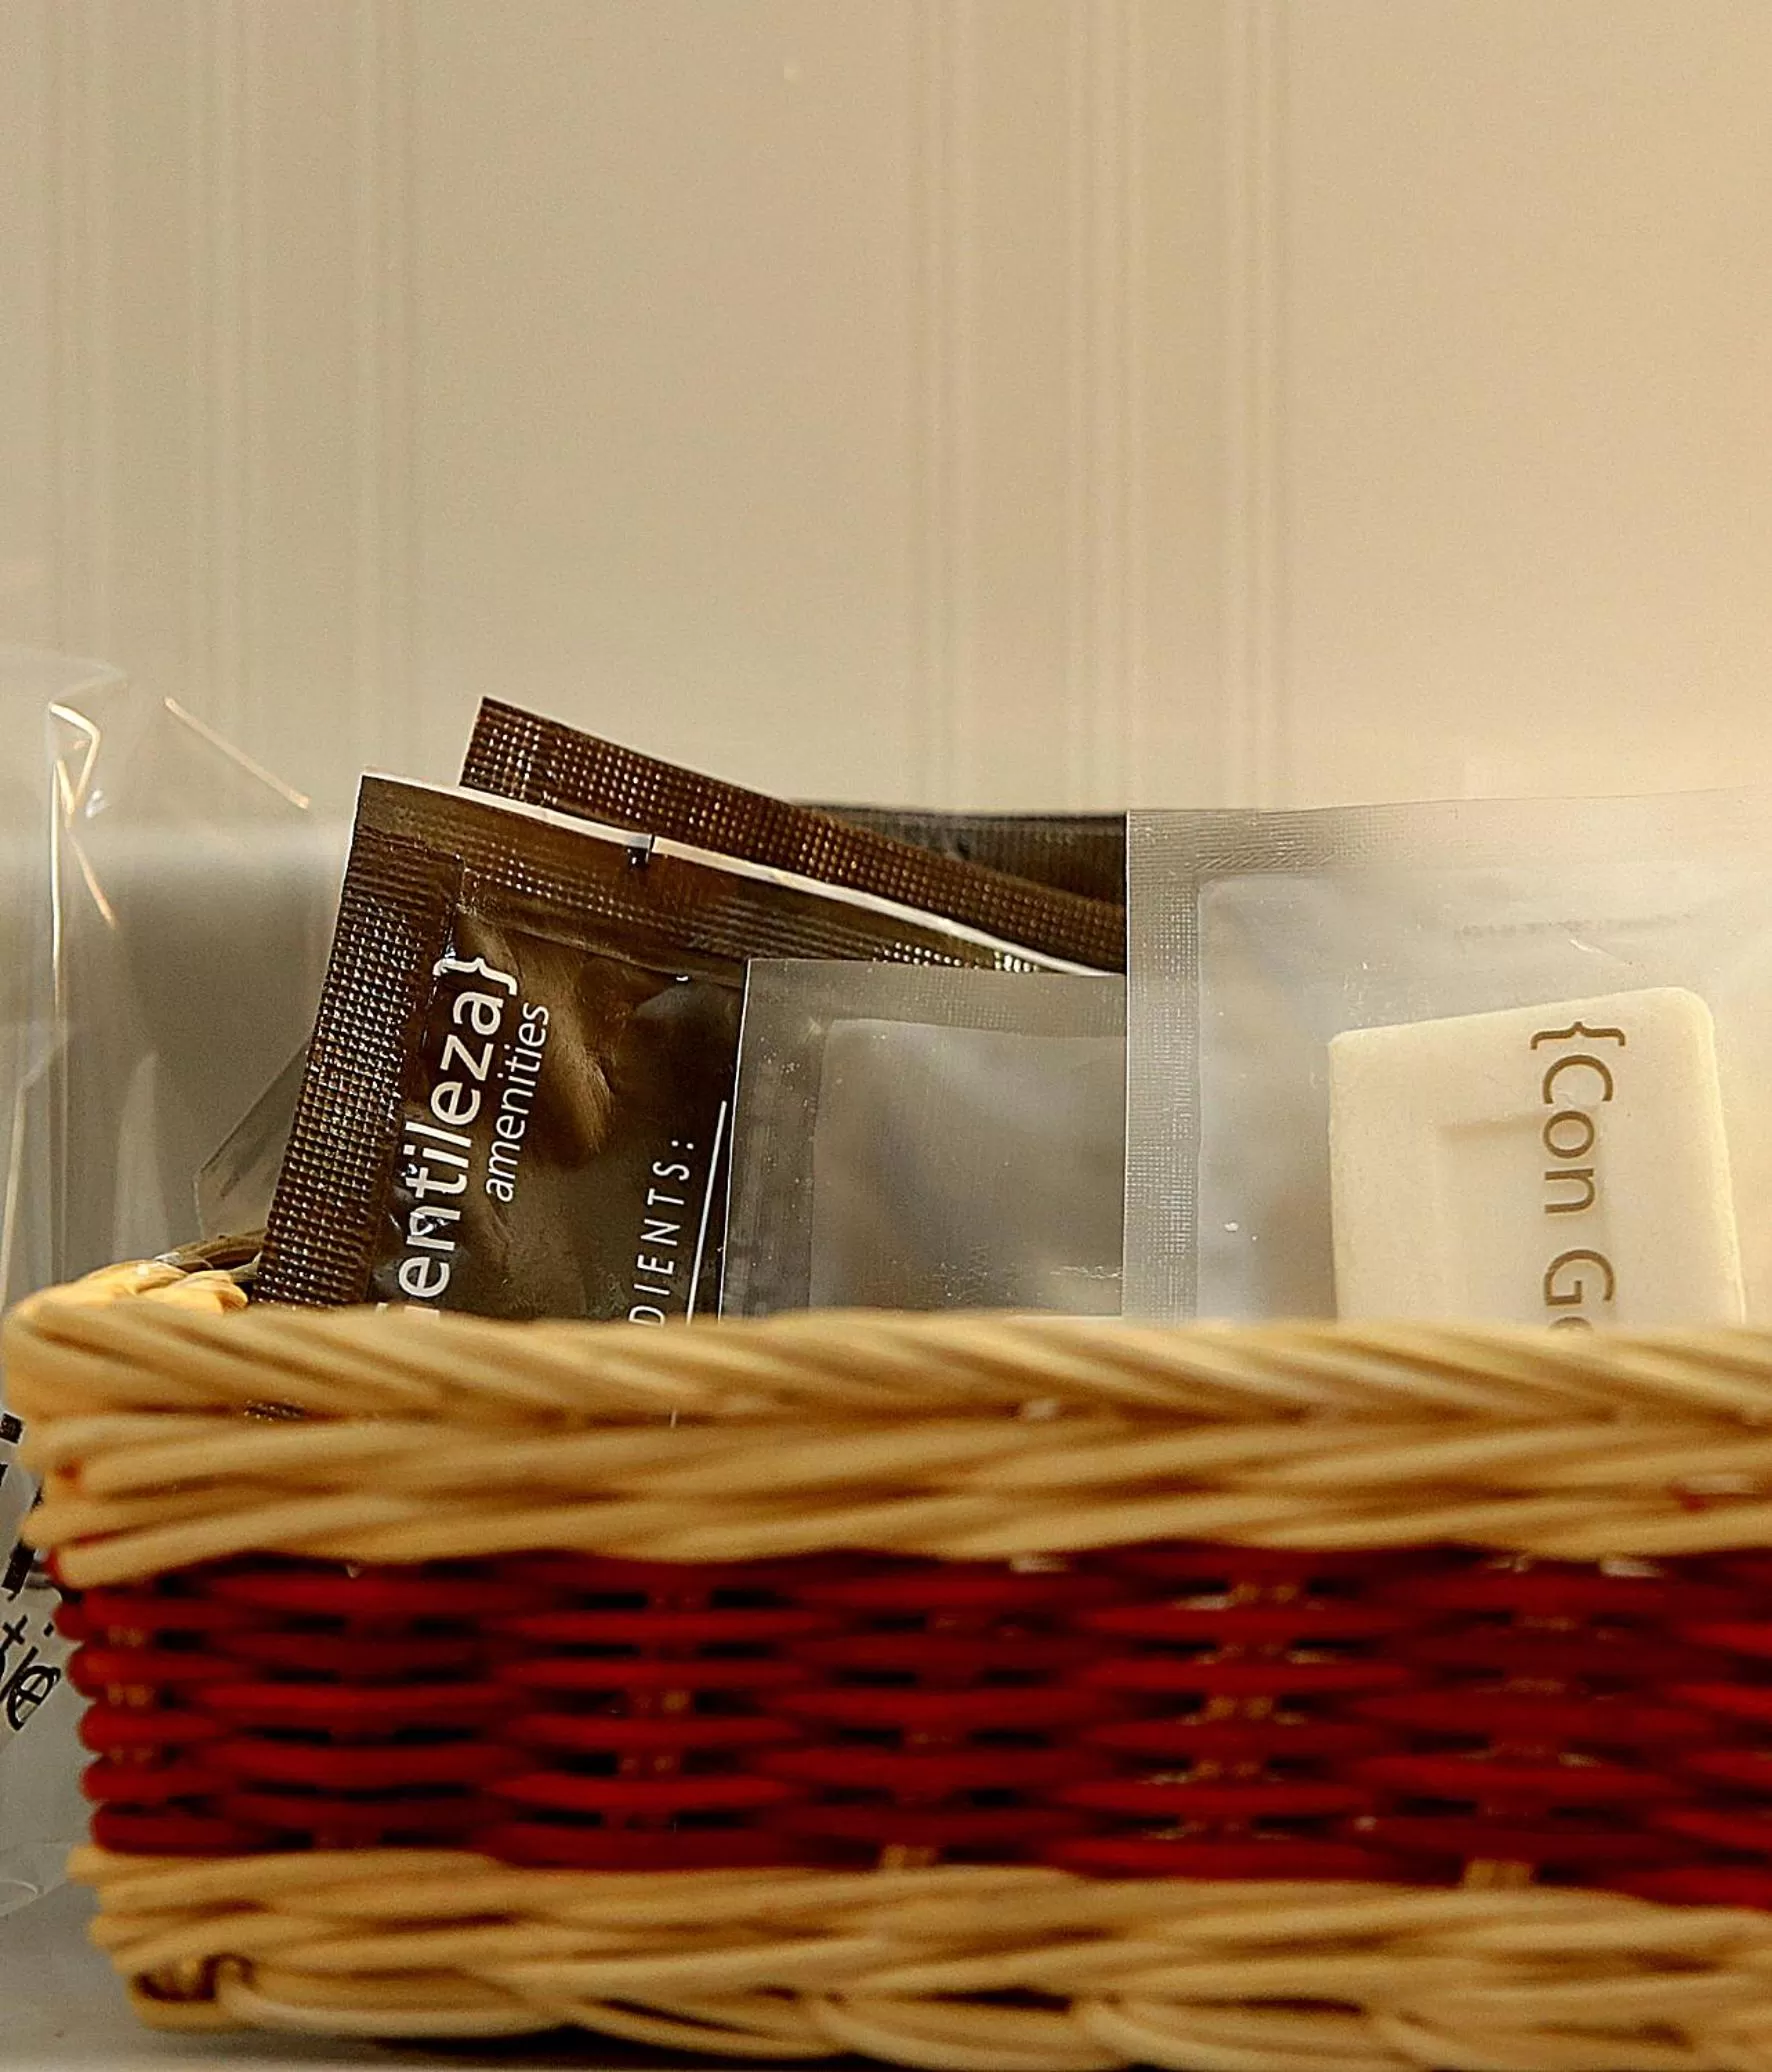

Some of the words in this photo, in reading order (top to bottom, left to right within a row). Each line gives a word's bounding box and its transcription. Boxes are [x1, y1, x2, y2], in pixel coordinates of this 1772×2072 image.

[377, 955, 518, 1320] entileza}
[486, 1001, 549, 1203] amenities
[1530, 1021, 1626, 1214] {Con
